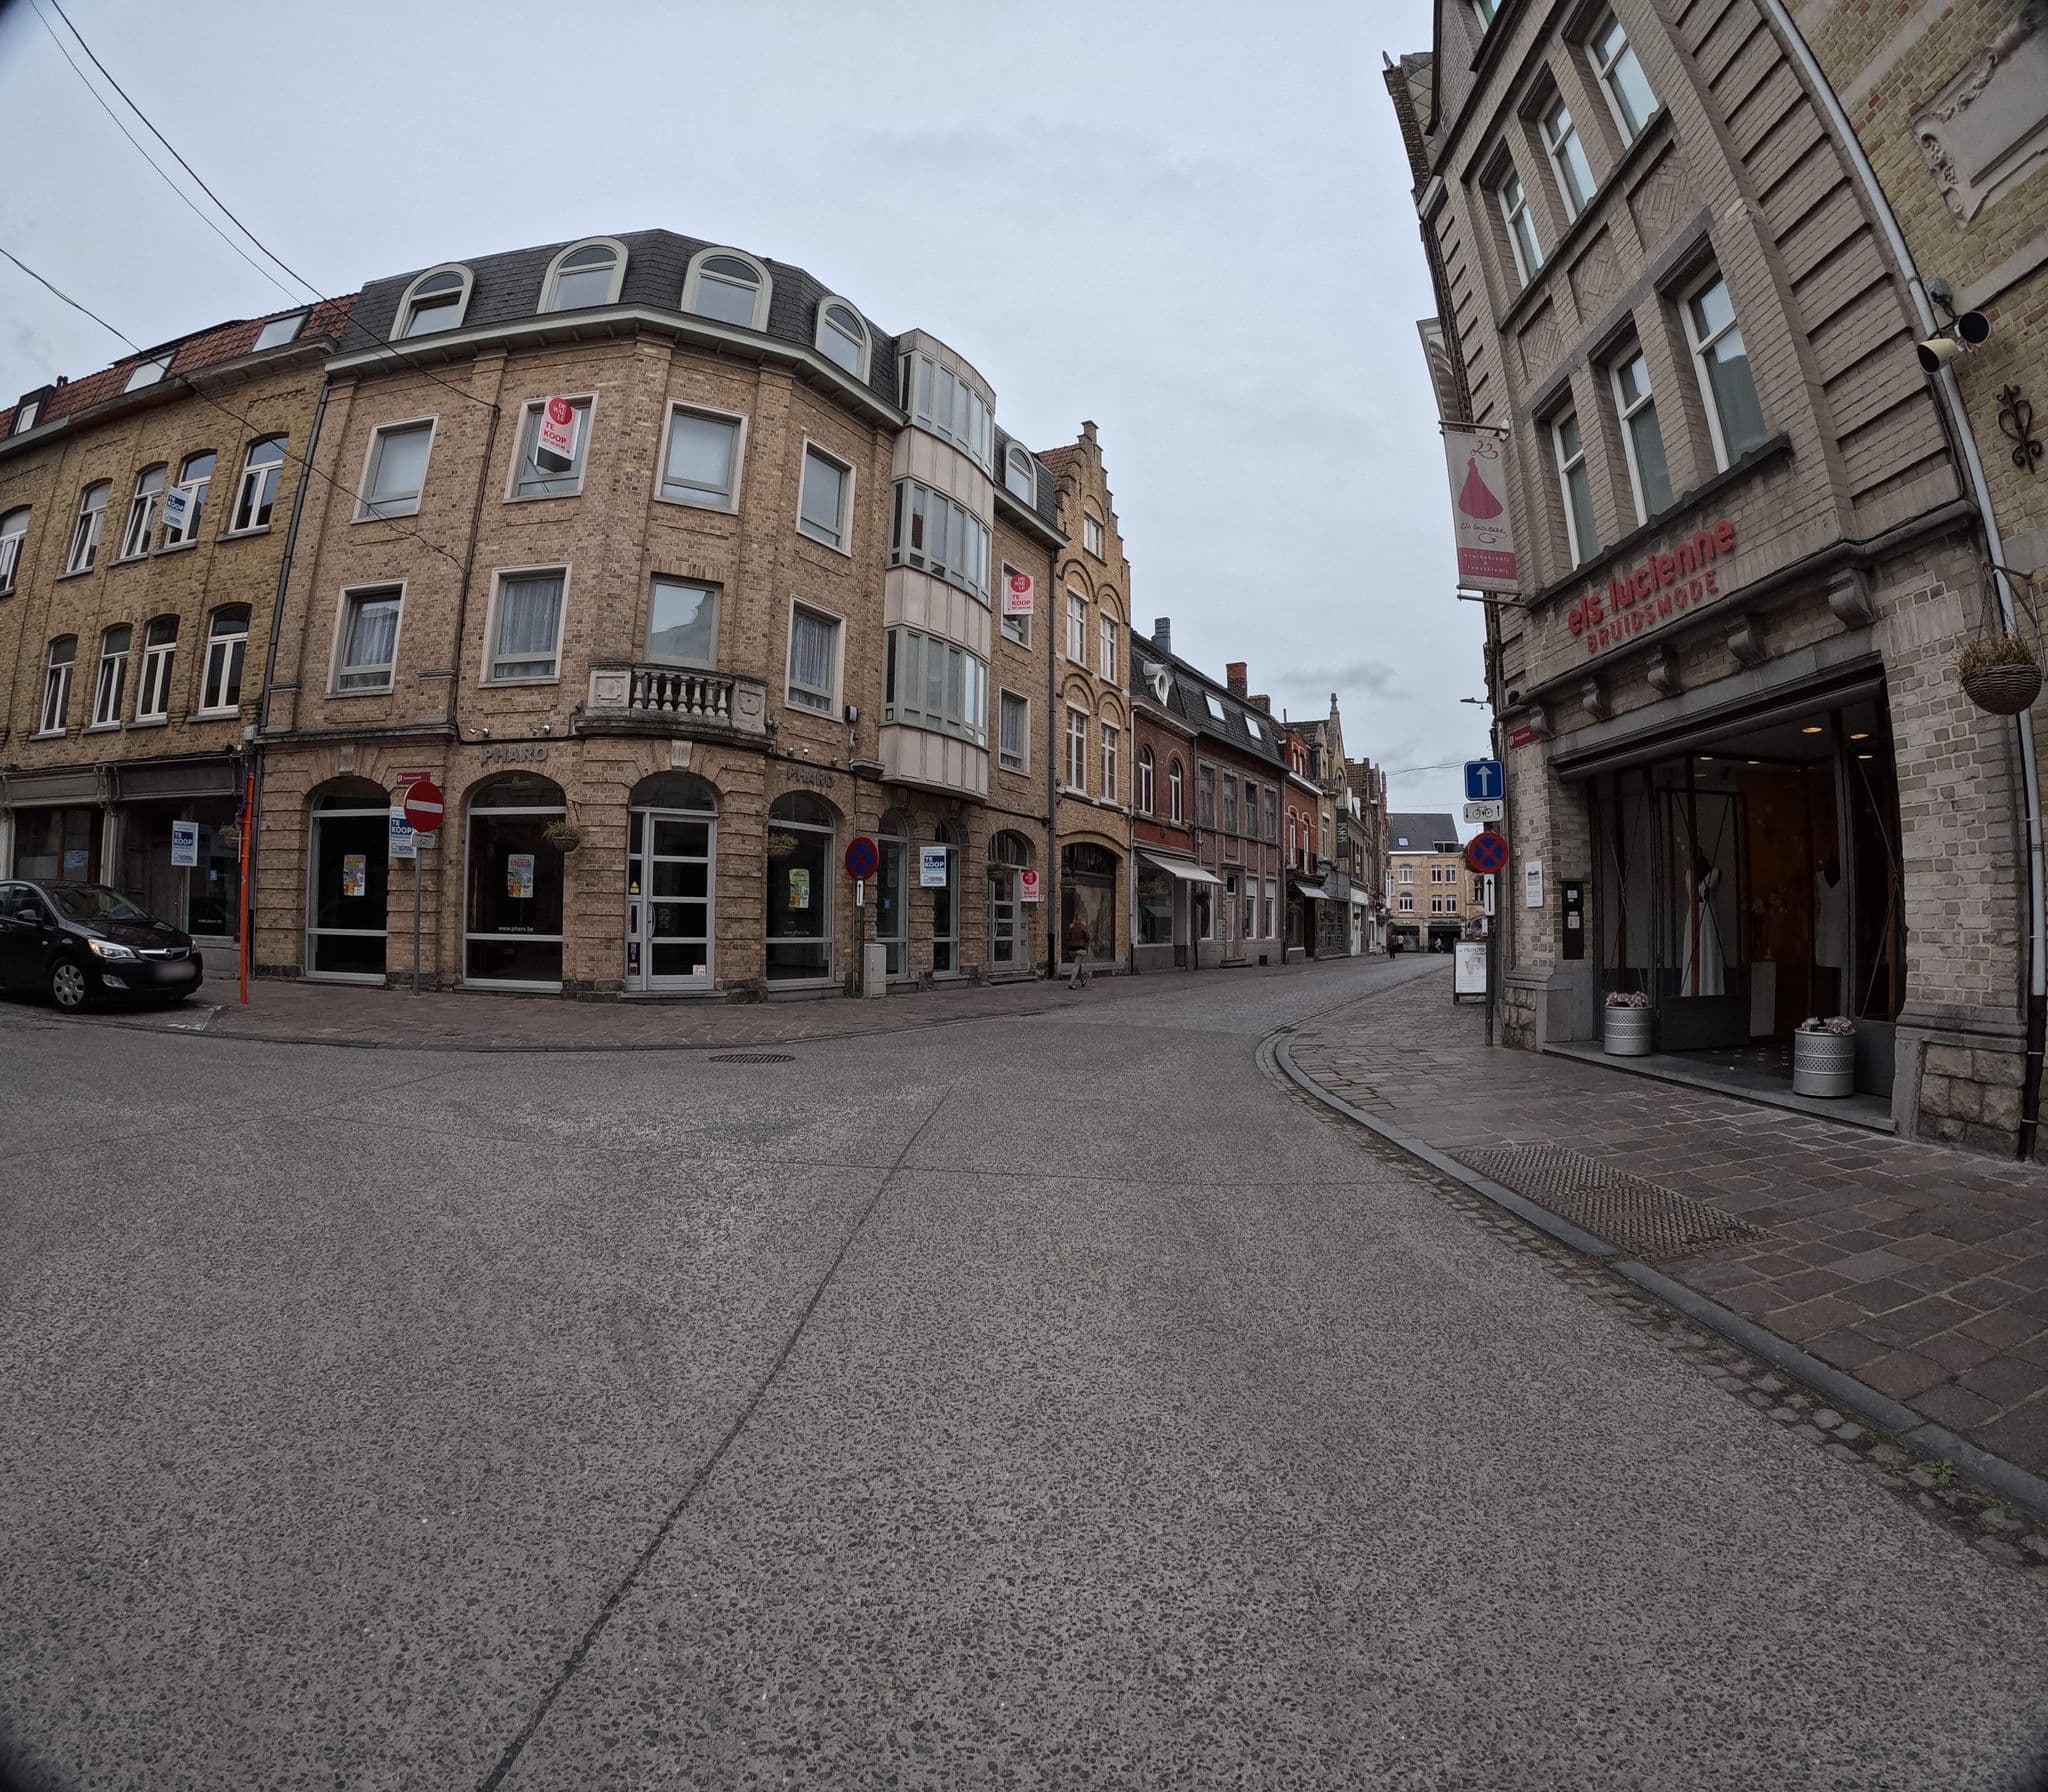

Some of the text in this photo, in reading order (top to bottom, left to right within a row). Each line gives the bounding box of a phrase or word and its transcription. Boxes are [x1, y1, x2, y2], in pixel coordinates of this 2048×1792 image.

[545, 421, 554, 431] TE
[543, 429, 566, 443] KOOP
[1567, 518, 1735, 636] els lucienne
[1585, 568, 1719, 653] BRUIDSMODE
[482, 748, 548, 764] PHARO
[391, 819, 401, 827] TE
[391, 826, 413, 835] KOOP
[174, 838, 193, 846] KOOP
